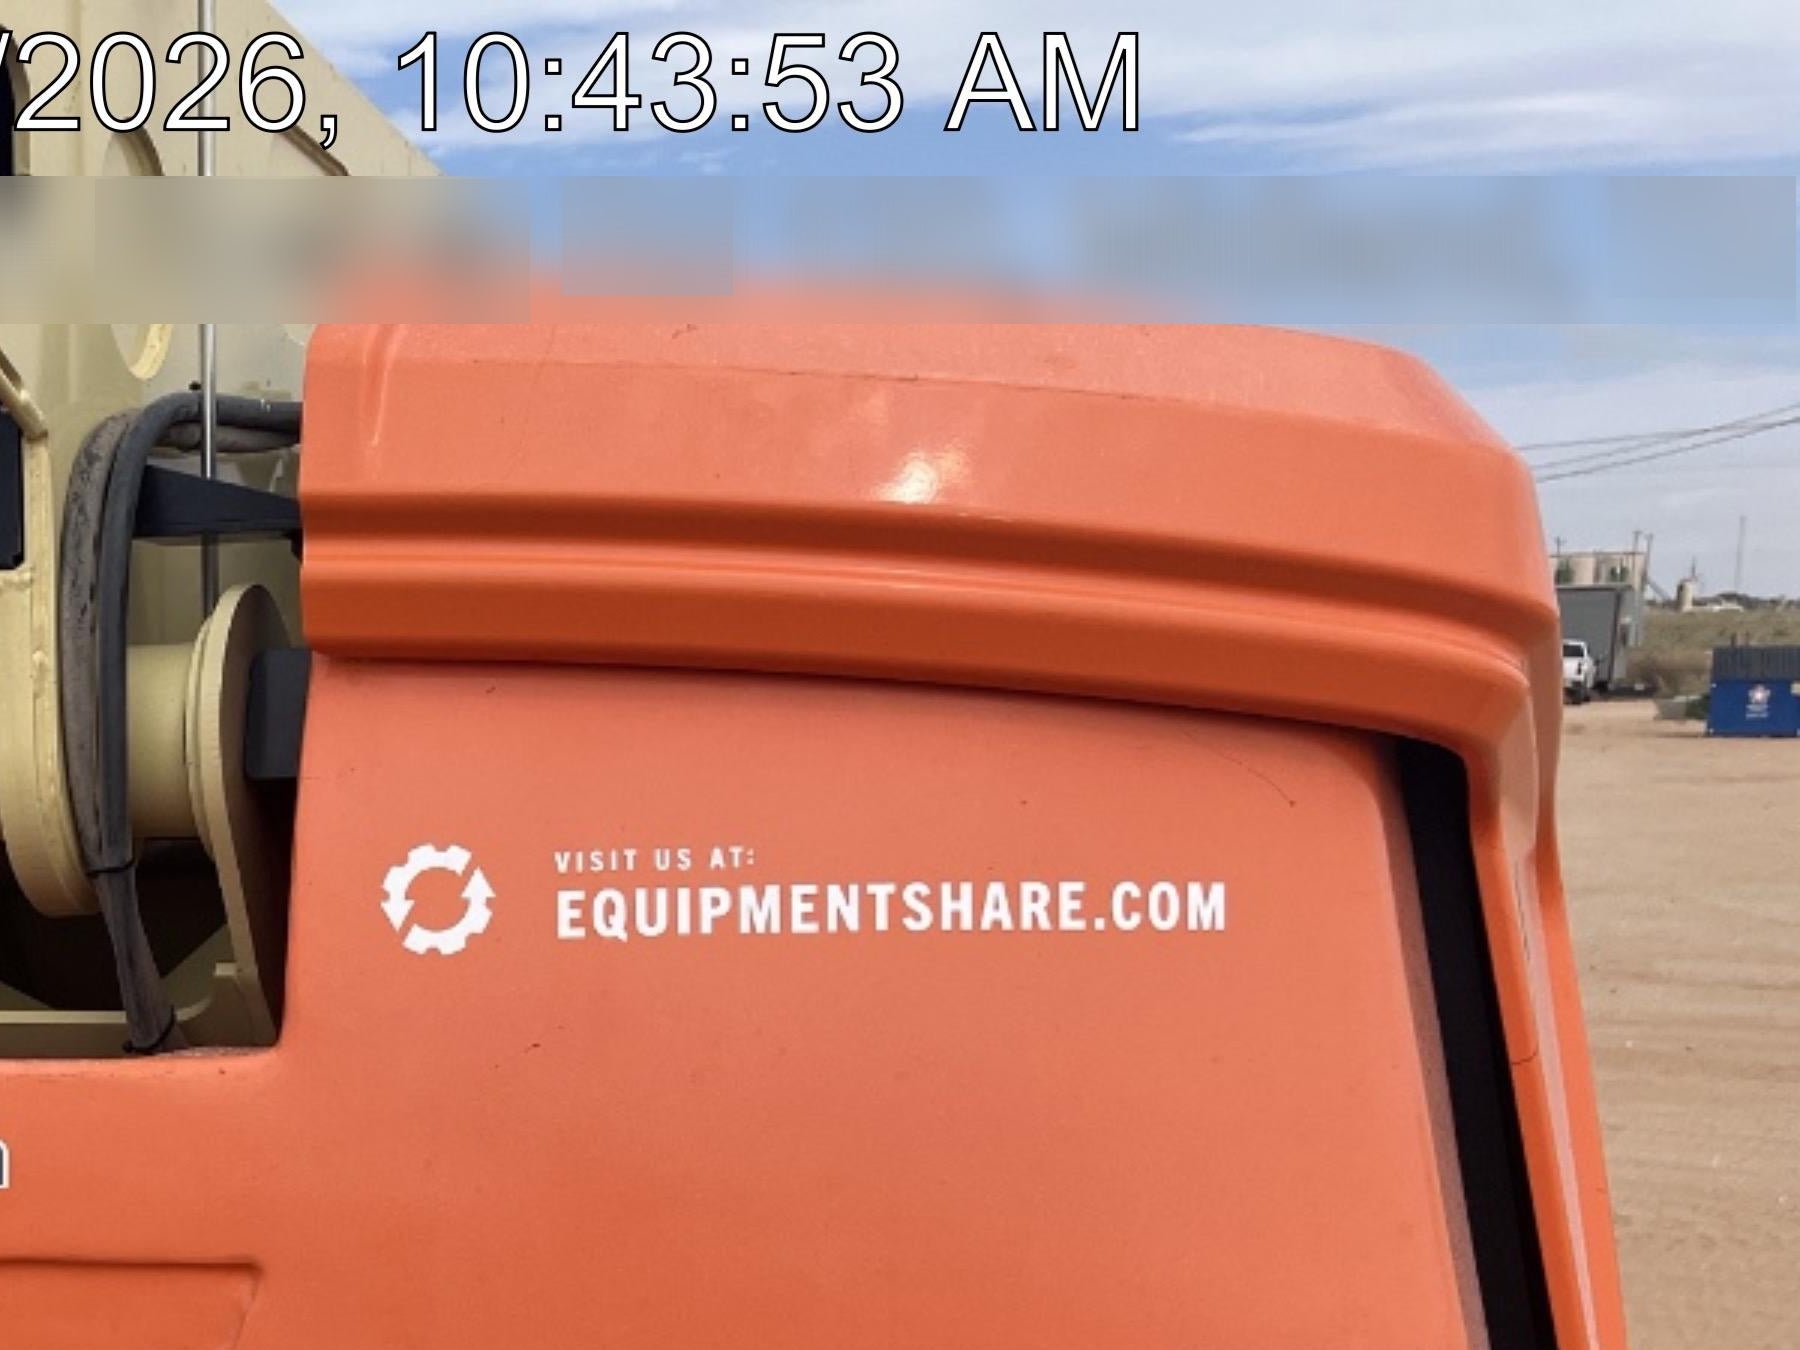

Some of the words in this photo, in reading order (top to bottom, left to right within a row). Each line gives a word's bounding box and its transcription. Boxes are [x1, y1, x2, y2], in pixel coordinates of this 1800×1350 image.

[554, 848, 638, 874] VISIT
[655, 847, 692, 871] US
[709, 845, 755, 870] AT:
[556, 880, 1229, 943] EQUIPMENTSHARE.COM
